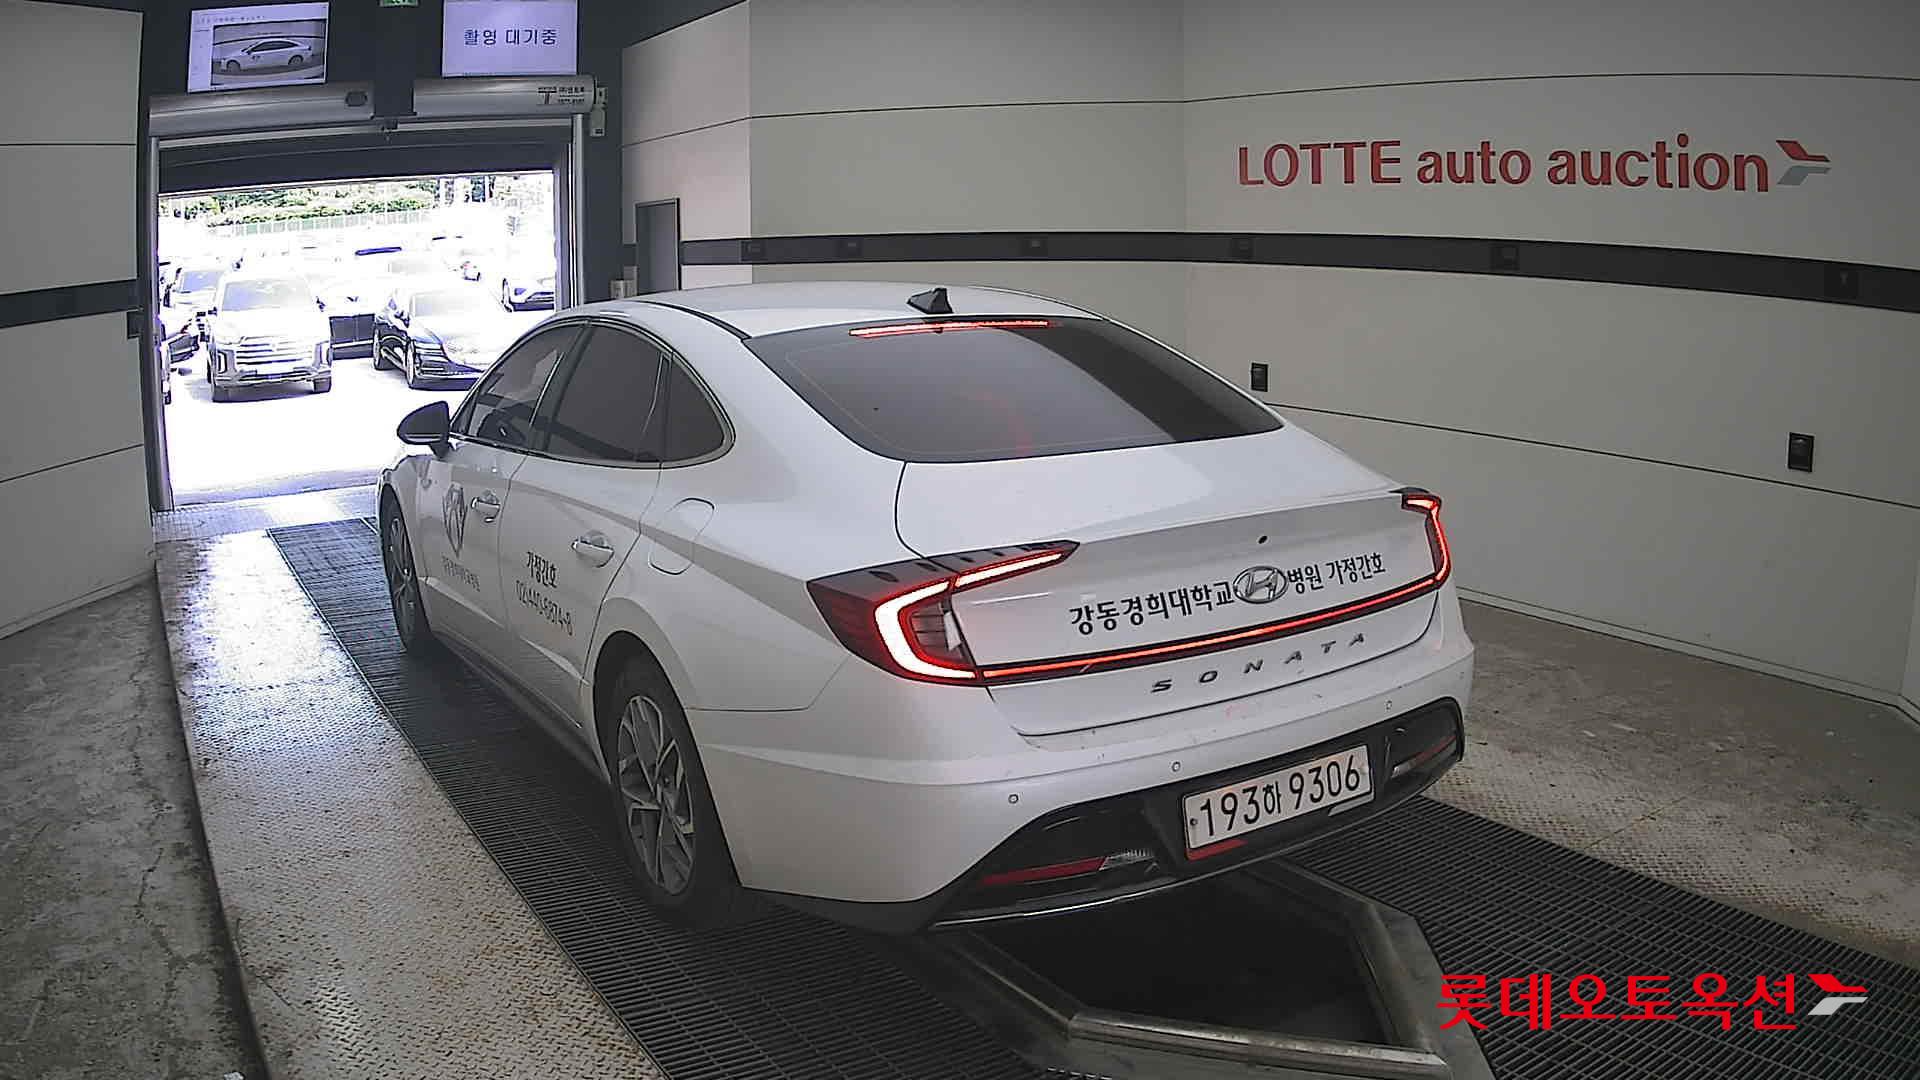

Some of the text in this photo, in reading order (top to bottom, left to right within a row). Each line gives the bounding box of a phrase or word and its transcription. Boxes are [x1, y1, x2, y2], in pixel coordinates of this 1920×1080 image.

[464, 29, 557, 46] 촬영 대기중
[1238, 133, 1769, 193] LOTTE auto auction
[1069, 551, 1387, 636] 강동경희대학교 병원 가정간호
[1150, 632, 1366, 694] SONATA
[1199, 754, 1361, 837] 193하 9306
